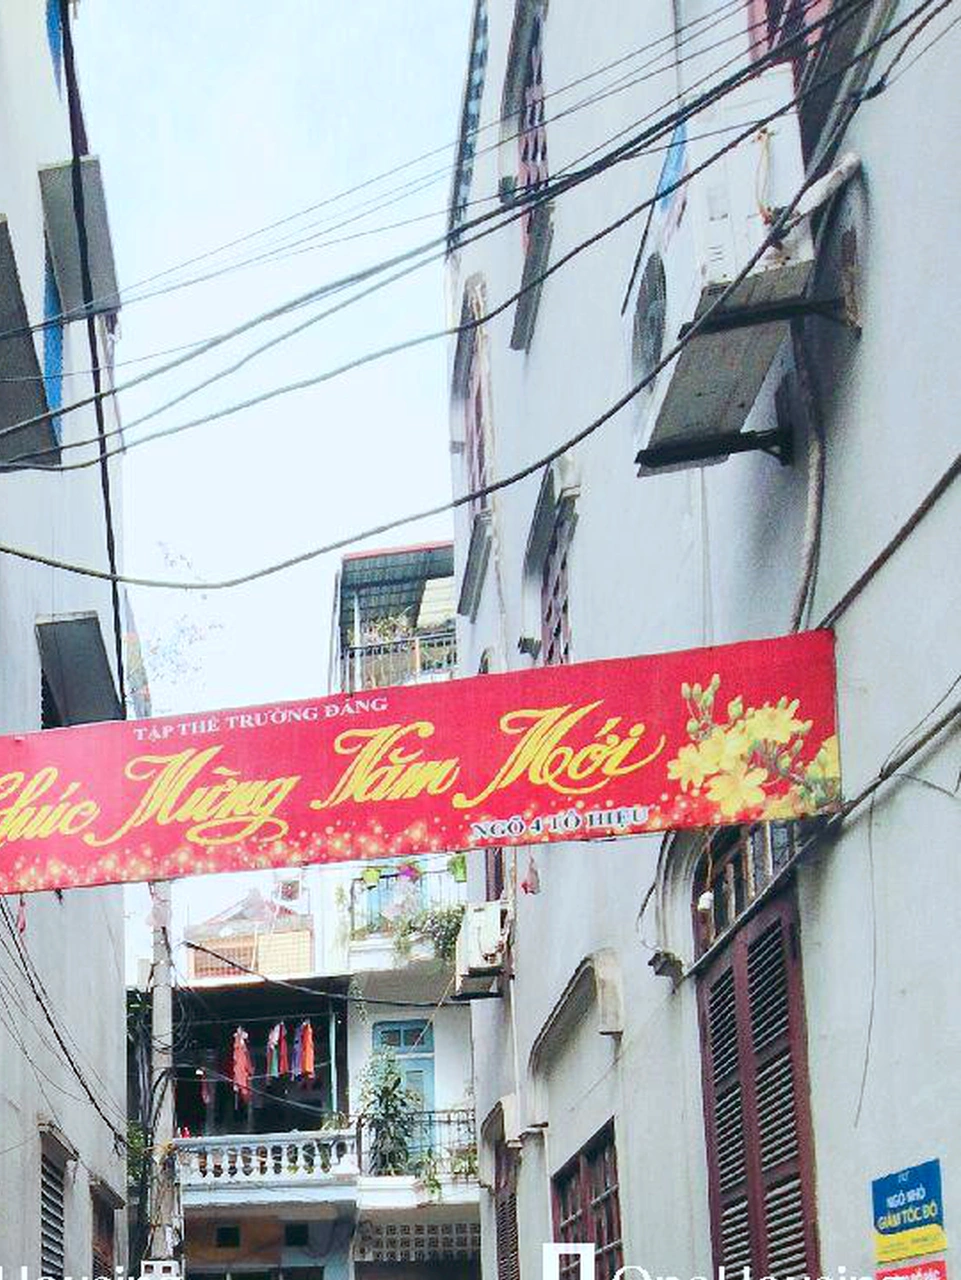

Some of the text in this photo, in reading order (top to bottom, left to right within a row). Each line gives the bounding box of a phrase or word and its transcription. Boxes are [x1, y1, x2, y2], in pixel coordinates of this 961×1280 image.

[85, 745, 301, 846] Mừng
[310, 722, 461, 811] Năm
[452, 699, 667, 809] Mới
[470, 814, 526, 840] NGÕ
[528, 815, 543, 833] 4
[586, 805, 652, 831] HIỆU
